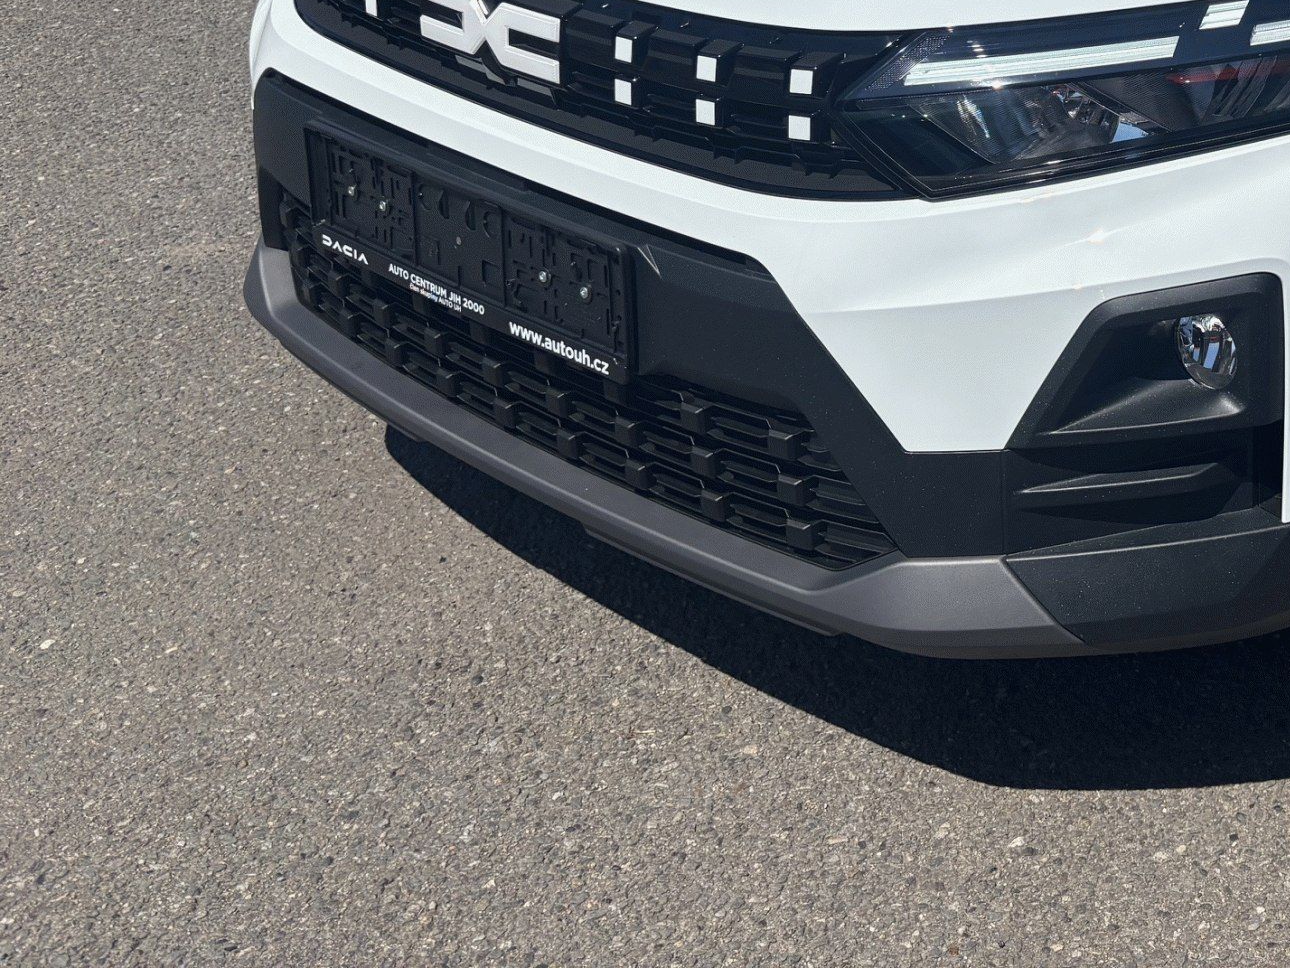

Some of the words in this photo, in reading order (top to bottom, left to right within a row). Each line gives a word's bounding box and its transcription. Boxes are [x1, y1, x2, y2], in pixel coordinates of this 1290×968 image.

[322, 234, 369, 265] DACIA
[388, 263, 410, 280] AUTO
[410, 273, 448, 297] CENTRUM
[448, 290, 462, 305] JIH
[463, 297, 485, 315] 2000
[438, 297, 453, 308] AUTO
[453, 303, 462, 313] UH
[509, 321, 610, 375] www.autouh.cz
